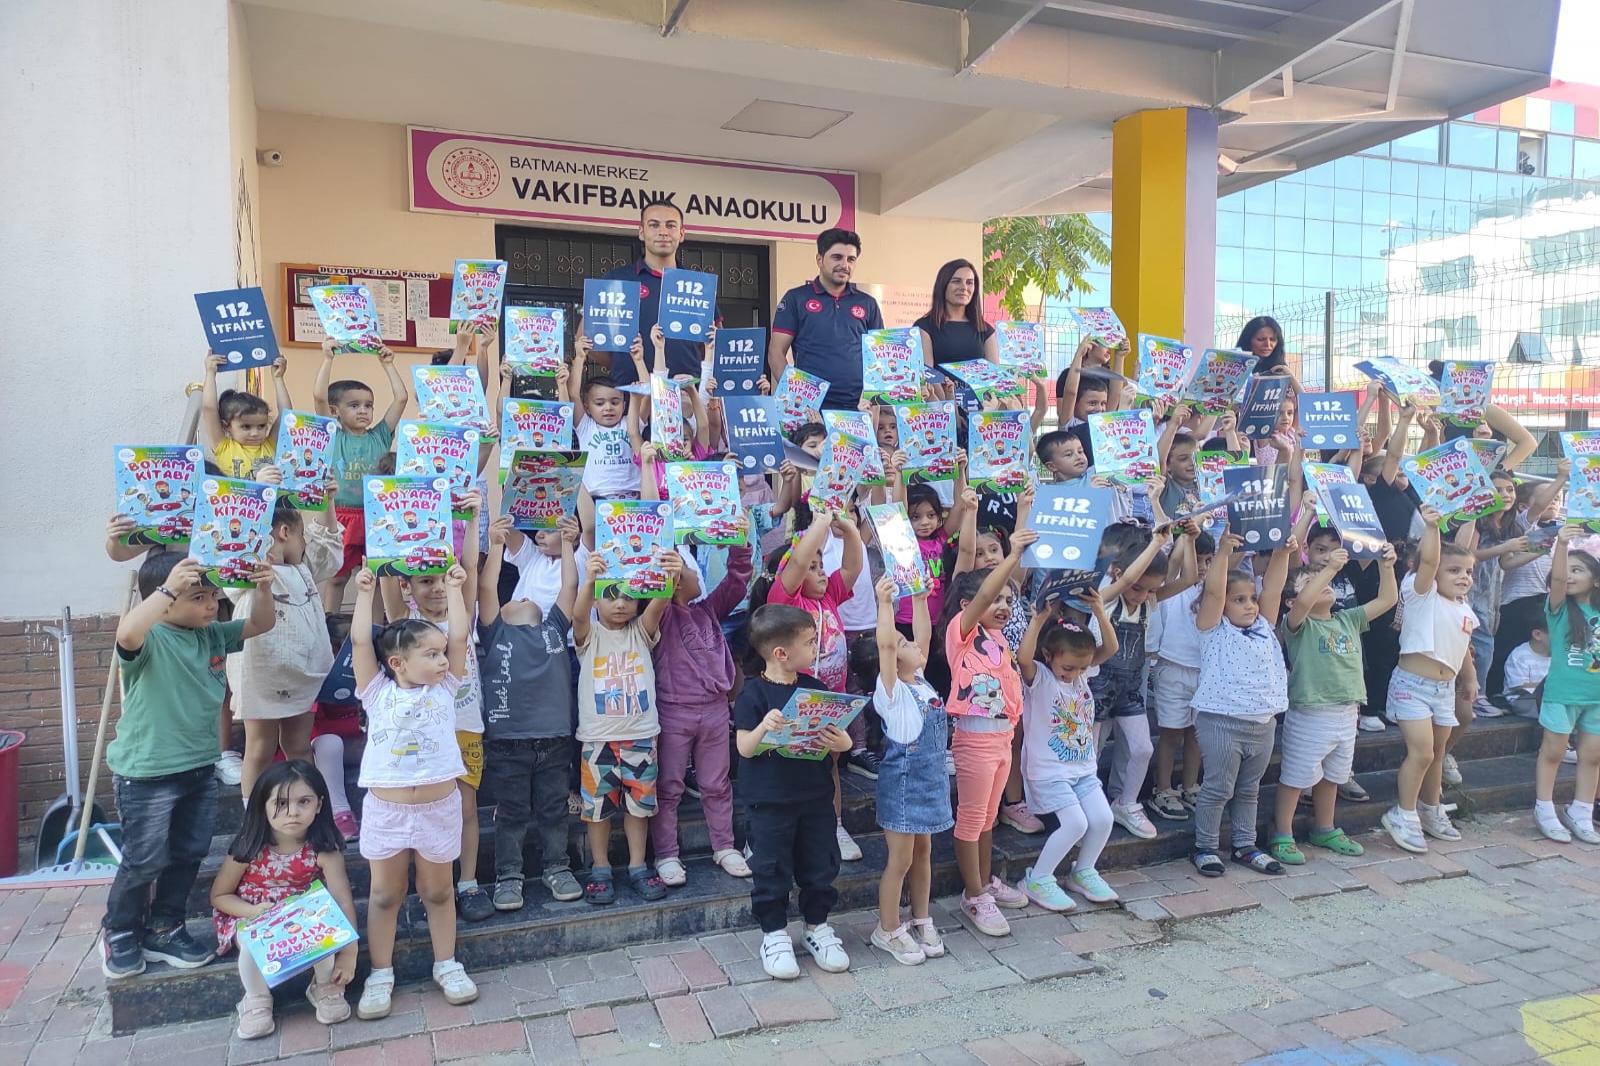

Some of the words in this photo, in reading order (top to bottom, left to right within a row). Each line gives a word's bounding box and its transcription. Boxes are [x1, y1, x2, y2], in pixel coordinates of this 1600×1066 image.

[510, 156, 649, 182] BATMAN-MERKEZ
[512, 177, 676, 210] VAKIFBANK
[685, 194, 827, 224] ANAOKULU
[320, 266, 360, 275] DUYURU
[377, 267, 397, 277] İLAN
[402, 271, 438, 279] PANOSU
[676, 280, 704, 296] 112
[598, 291, 626, 306] 112
[216, 301, 252, 318] 112
[728, 339, 754, 352] 112
[1263, 388, 1281, 400] 112
[1313, 401, 1342, 411] 112
[513, 412, 566, 427] BOYAMA
[740, 408, 767, 423] 112
[906, 412, 950, 425] BOYAMA
[978, 421, 1023, 433] BOYAMA
[289, 427, 330, 443] BOYAMA
[411, 436, 471, 452] BOYAMA
[128, 458, 195, 473] BOYAMA
[1417, 450, 1468, 476] BOYAMA
[1241, 479, 1275, 494] 112
[377, 489, 442, 503] BOYAMA
[1341, 494, 1364, 509] 112
[209, 495, 267, 513] BOYAMA
[1053, 497, 1091, 514] 112
[606, 513, 665, 527] BOYAMA
[1035, 512, 1097, 529] İTFAİYE
[798, 702, 853, 715] BOYAMA
